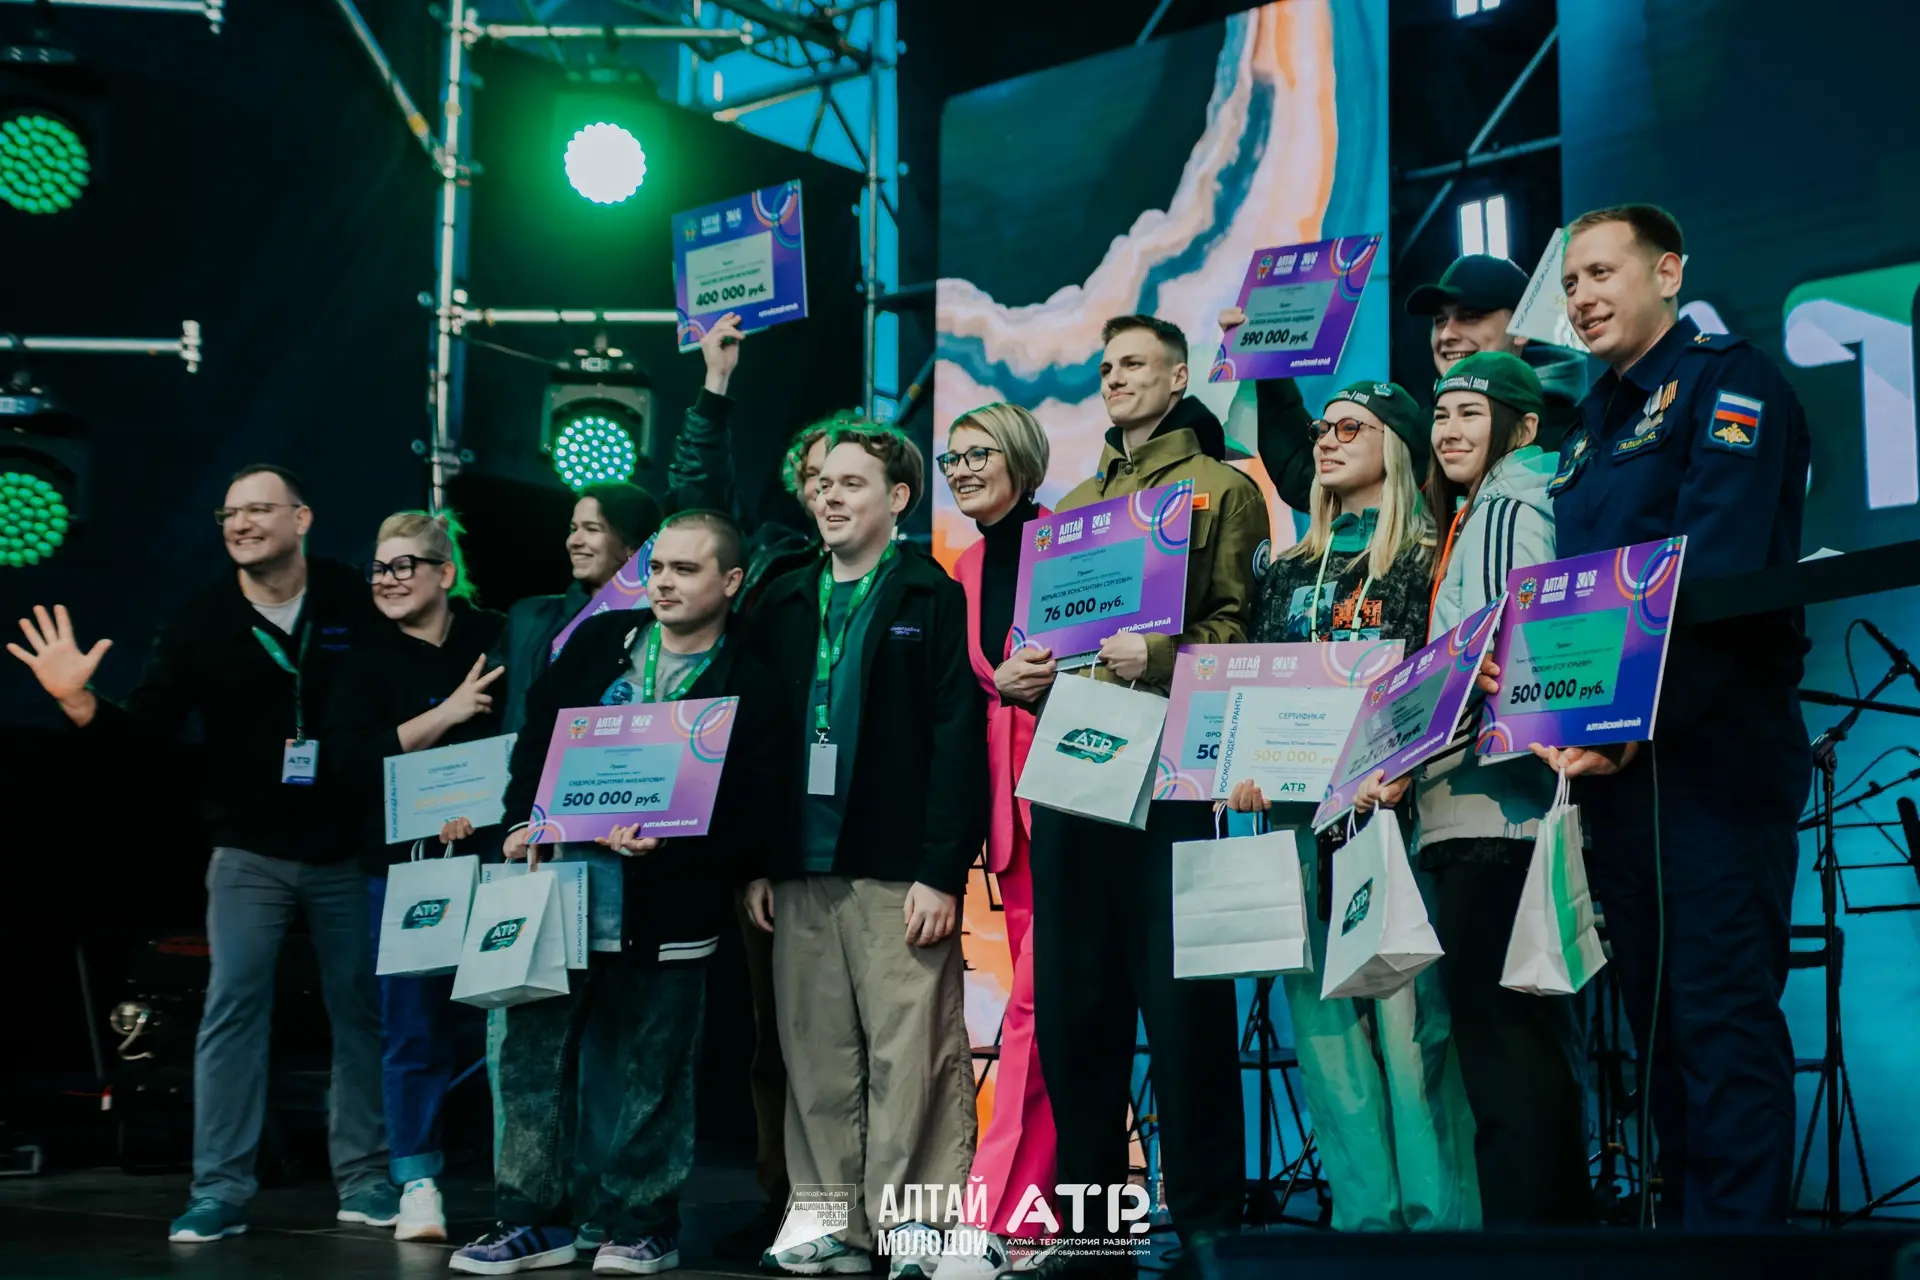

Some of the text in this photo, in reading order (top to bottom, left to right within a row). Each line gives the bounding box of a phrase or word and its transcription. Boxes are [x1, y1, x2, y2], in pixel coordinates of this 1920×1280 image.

[696, 283, 767, 307] 400 000 руб.
[1240, 329, 1308, 347] 590 000 руб.
[1059, 517, 1084, 537] АЛТАЙ
[1543, 573, 1569, 593] АЛТАЙ
[1044, 595, 1124, 623] 76 000 руб.
[1154, 616, 1171, 628] КРАЙ
[1228, 655, 1260, 670] АЛТАЙ
[1510, 679, 1605, 704] 500 000 руб.
[596, 715, 623, 729] АЛТАЙ
[1278, 712, 1327, 720] СЕРТИФИКАТ
[1585, 717, 1641, 732] АЛТАЙСКИЙ КРАЙ
[1074, 731, 1113, 750] АТР
[1252, 749, 1281, 763] 500
[1287, 750, 1317, 763] 000
[1280, 783, 1306, 793] АТР
[562, 790, 660, 807] 500 000 руб.
[642, 818, 698, 828] АЛТАЙСКИЙ КРАЙ
[412, 903, 441, 917] АТР
[491, 923, 517, 939] АТР
